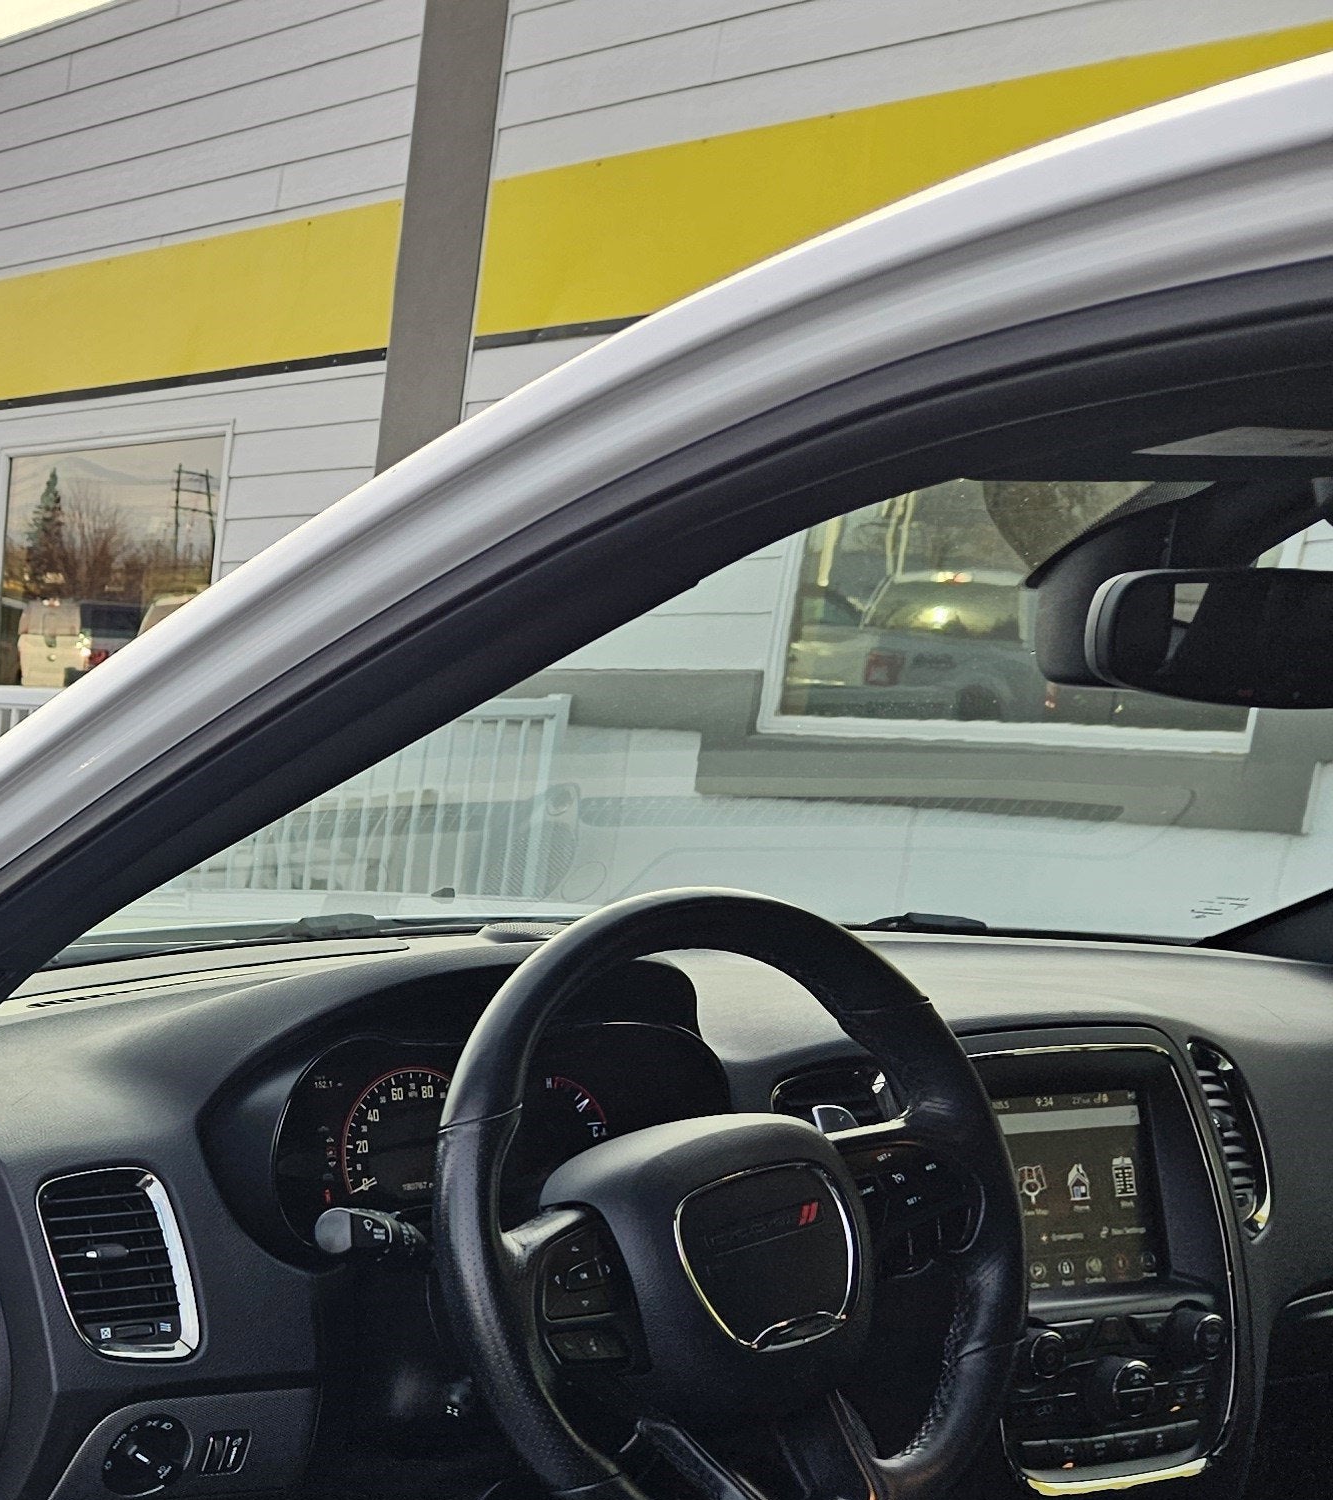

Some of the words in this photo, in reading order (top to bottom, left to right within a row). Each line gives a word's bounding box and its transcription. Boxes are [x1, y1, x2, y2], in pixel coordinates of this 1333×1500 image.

[391, 1088, 404, 1100] 60
[421, 1085, 434, 1098] 80
[367, 1109, 379, 1122] 40
[356, 1140, 369, 1153] 20
